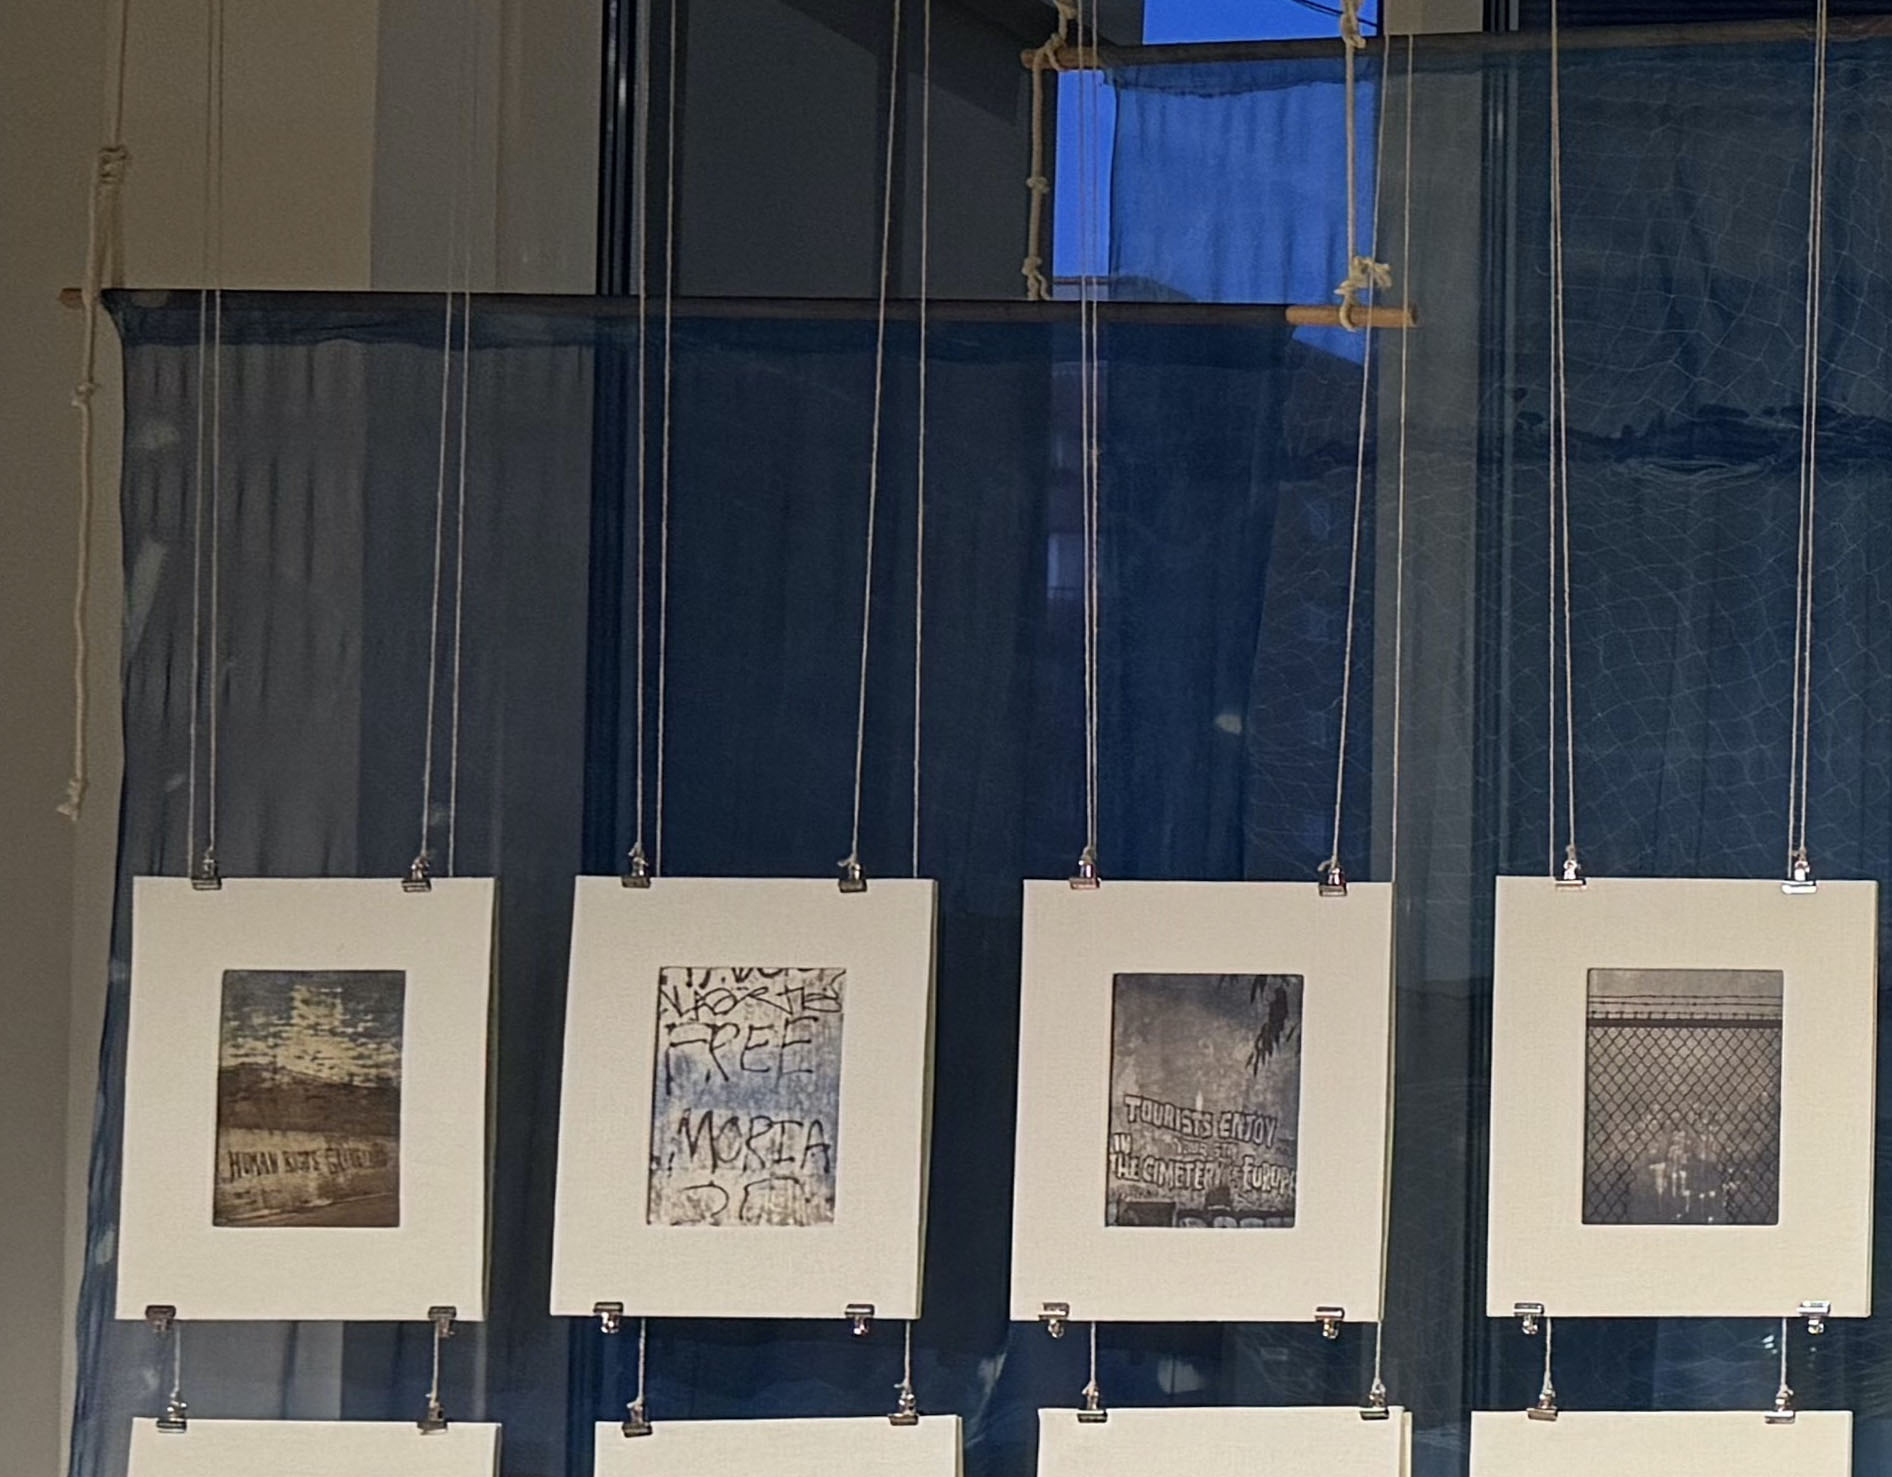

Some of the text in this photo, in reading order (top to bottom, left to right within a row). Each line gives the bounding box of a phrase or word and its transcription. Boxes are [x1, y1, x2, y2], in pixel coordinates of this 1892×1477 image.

[663, 1015, 820, 1097] FREE
[677, 1106, 831, 1175] MORIA
[1123, 1094, 1279, 1149] TOURISTS ENJOY
